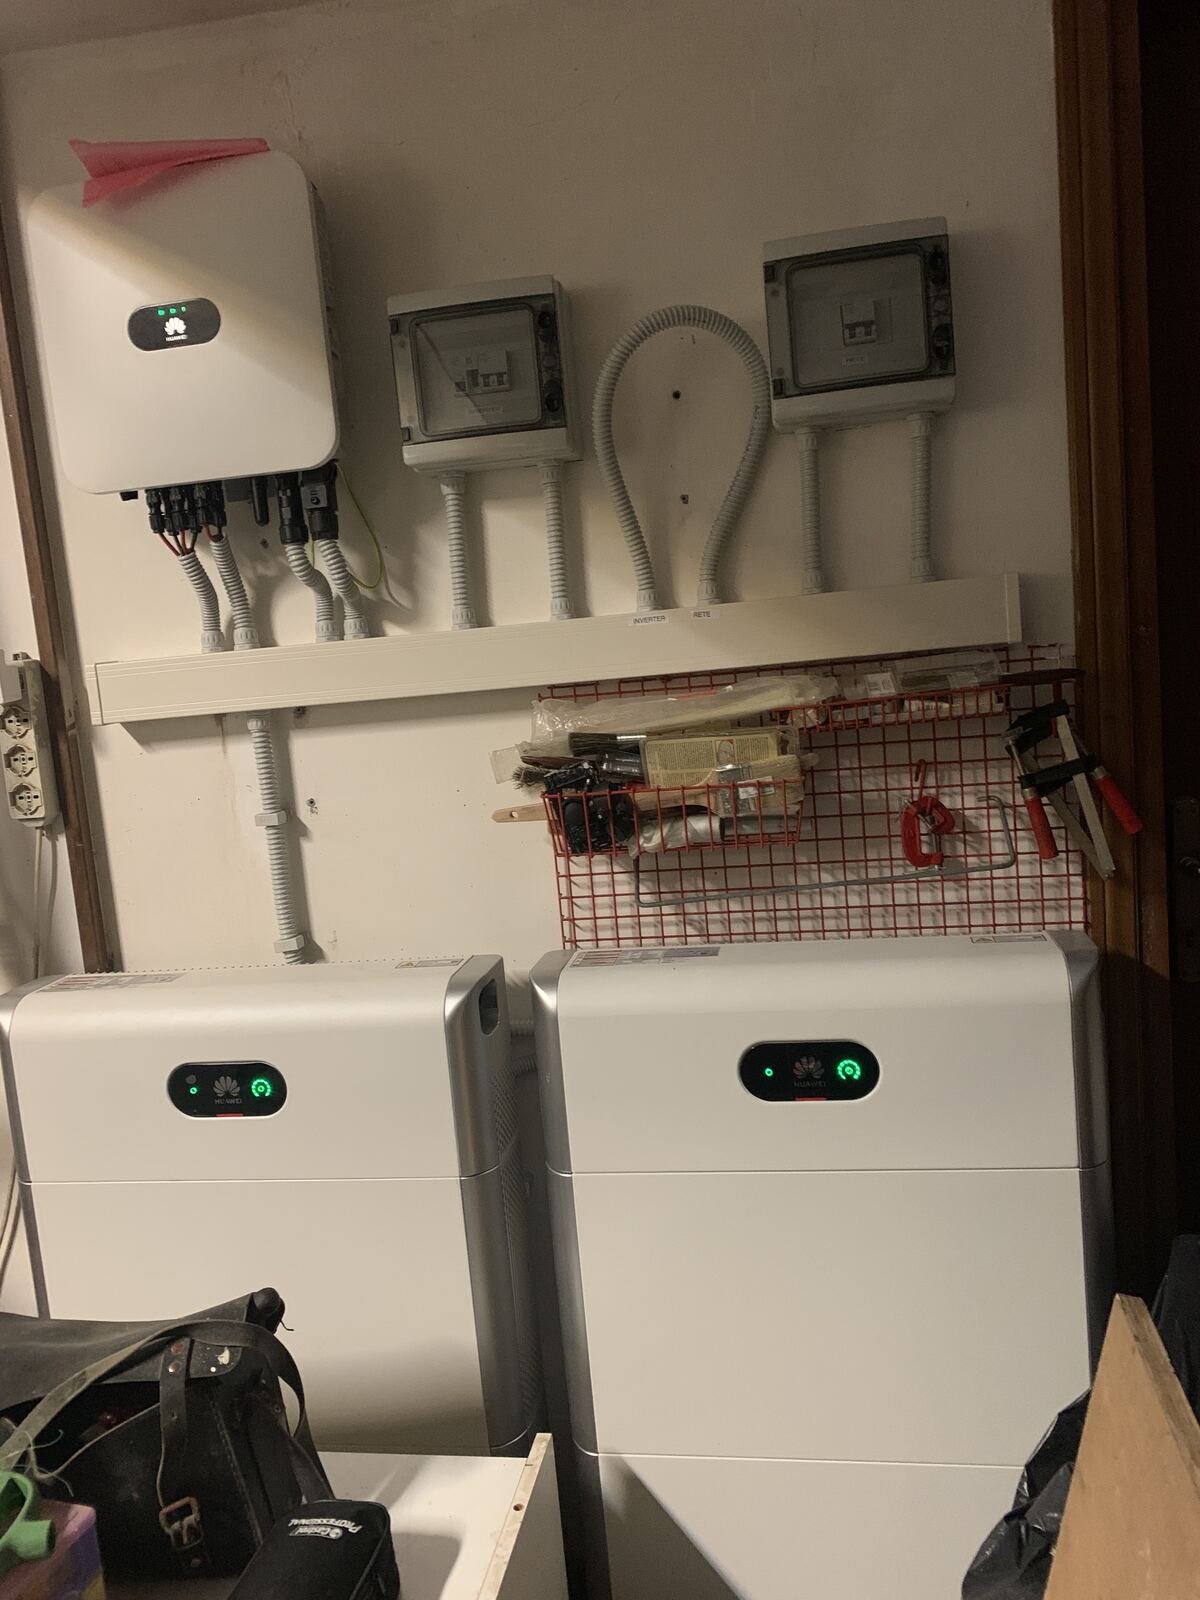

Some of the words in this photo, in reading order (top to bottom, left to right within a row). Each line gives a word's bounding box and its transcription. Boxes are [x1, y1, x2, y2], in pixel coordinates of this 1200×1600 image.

[633, 615, 666, 624] INVERTER
[793, 1080, 826, 1088] HUAWEI
[214, 1097, 243, 1105] HUAWEI
